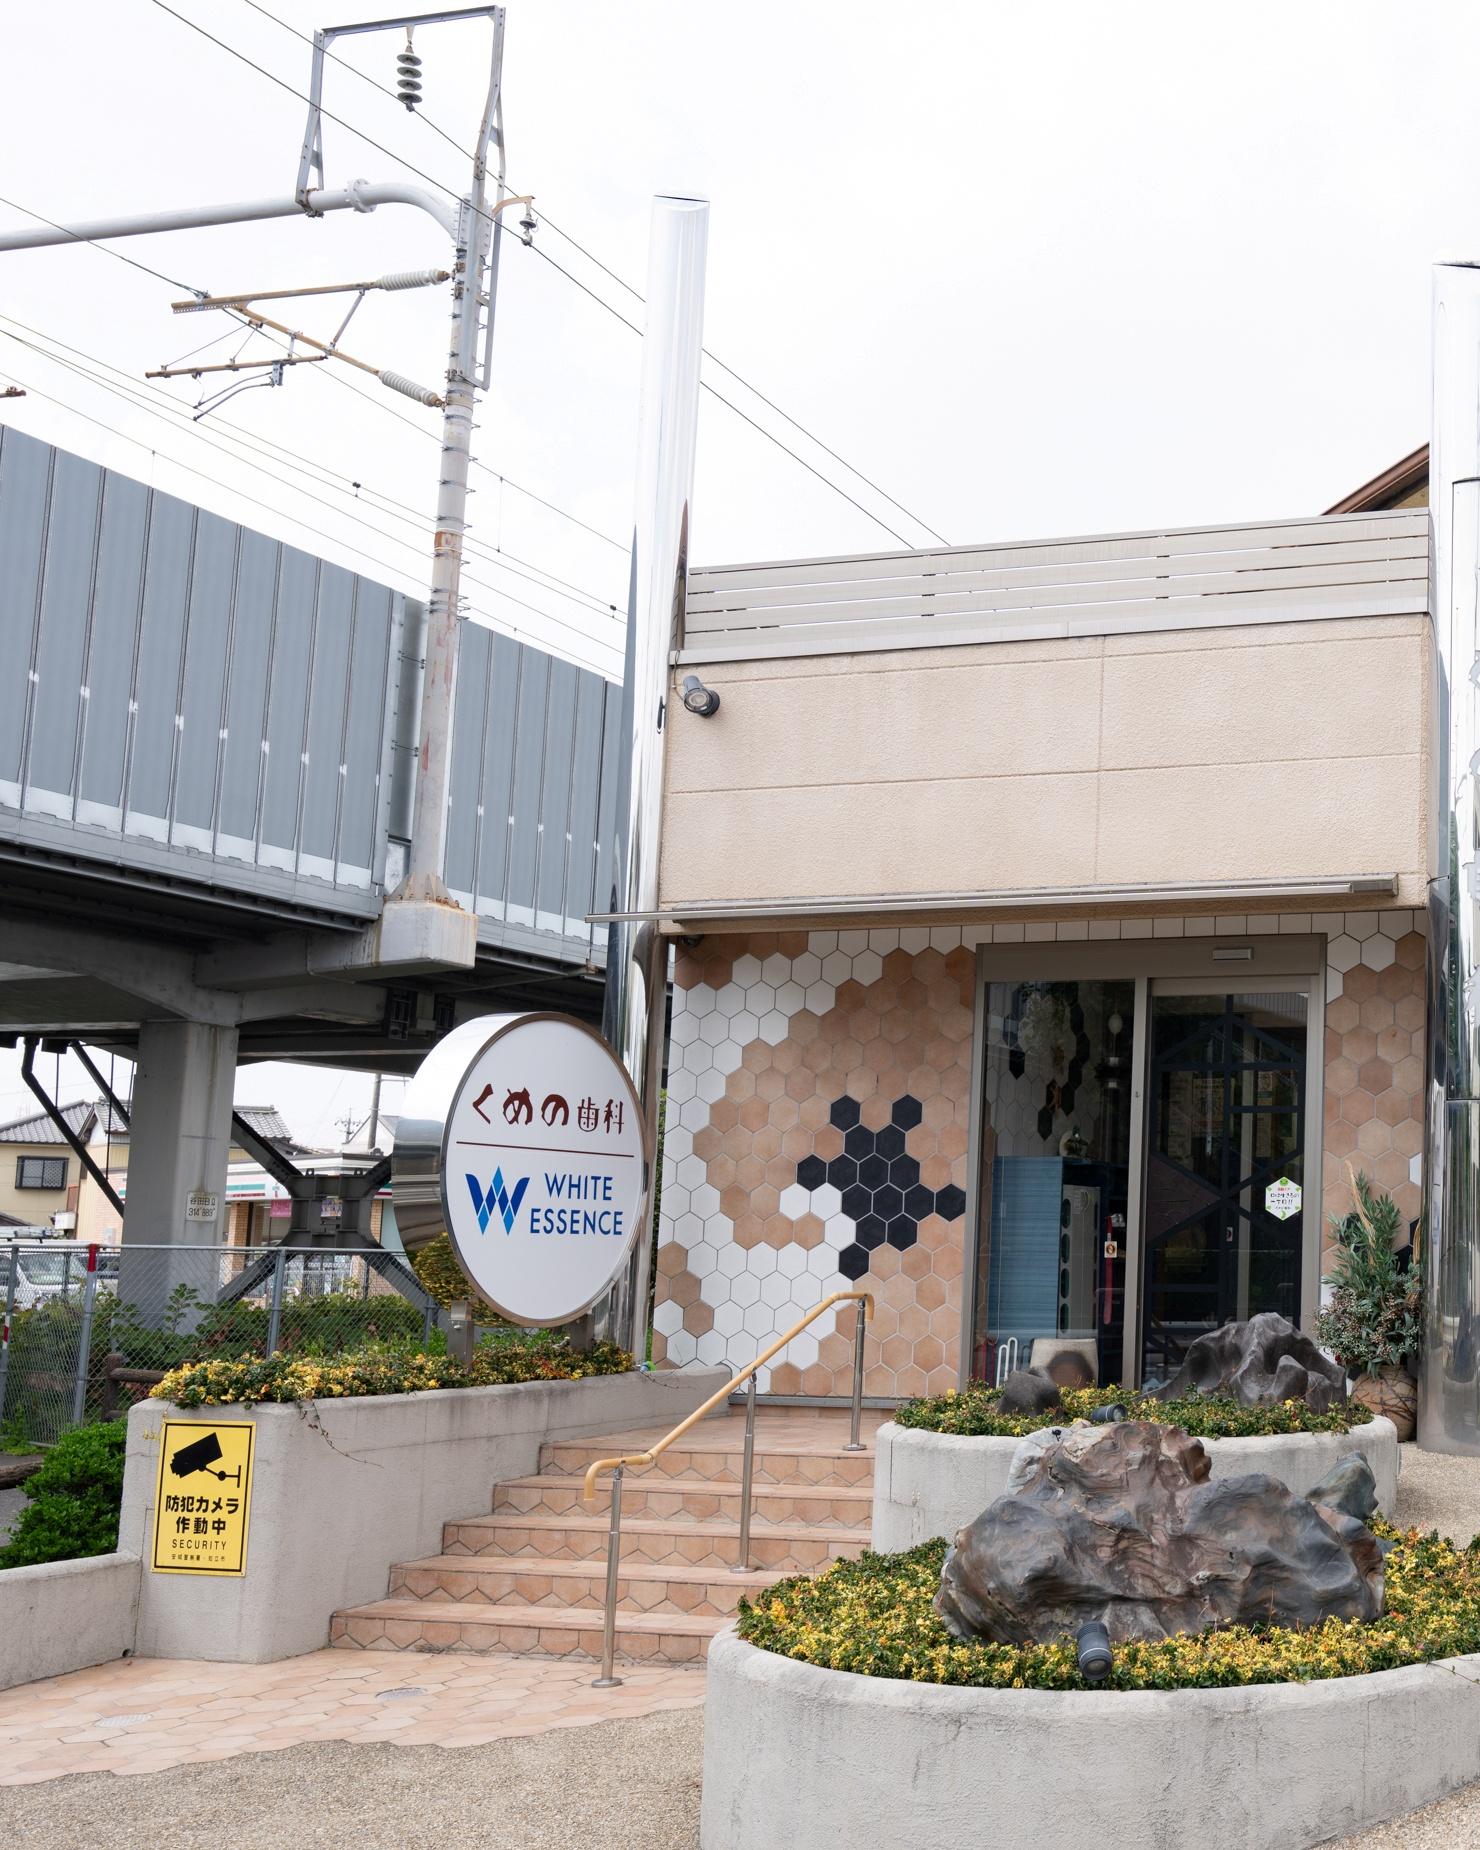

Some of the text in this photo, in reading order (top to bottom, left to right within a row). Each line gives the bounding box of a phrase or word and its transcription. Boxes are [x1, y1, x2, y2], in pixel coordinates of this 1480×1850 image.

[472, 1083, 625, 1134] くめの歯科
[544, 1172, 613, 1201] WHITE
[529, 1207, 623, 1236] ESSENCE
[165, 1495, 239, 1514] 防犯カメラ
[176, 1516, 226, 1535] 作動中
[171, 1538, 227, 1551] SECURITY
